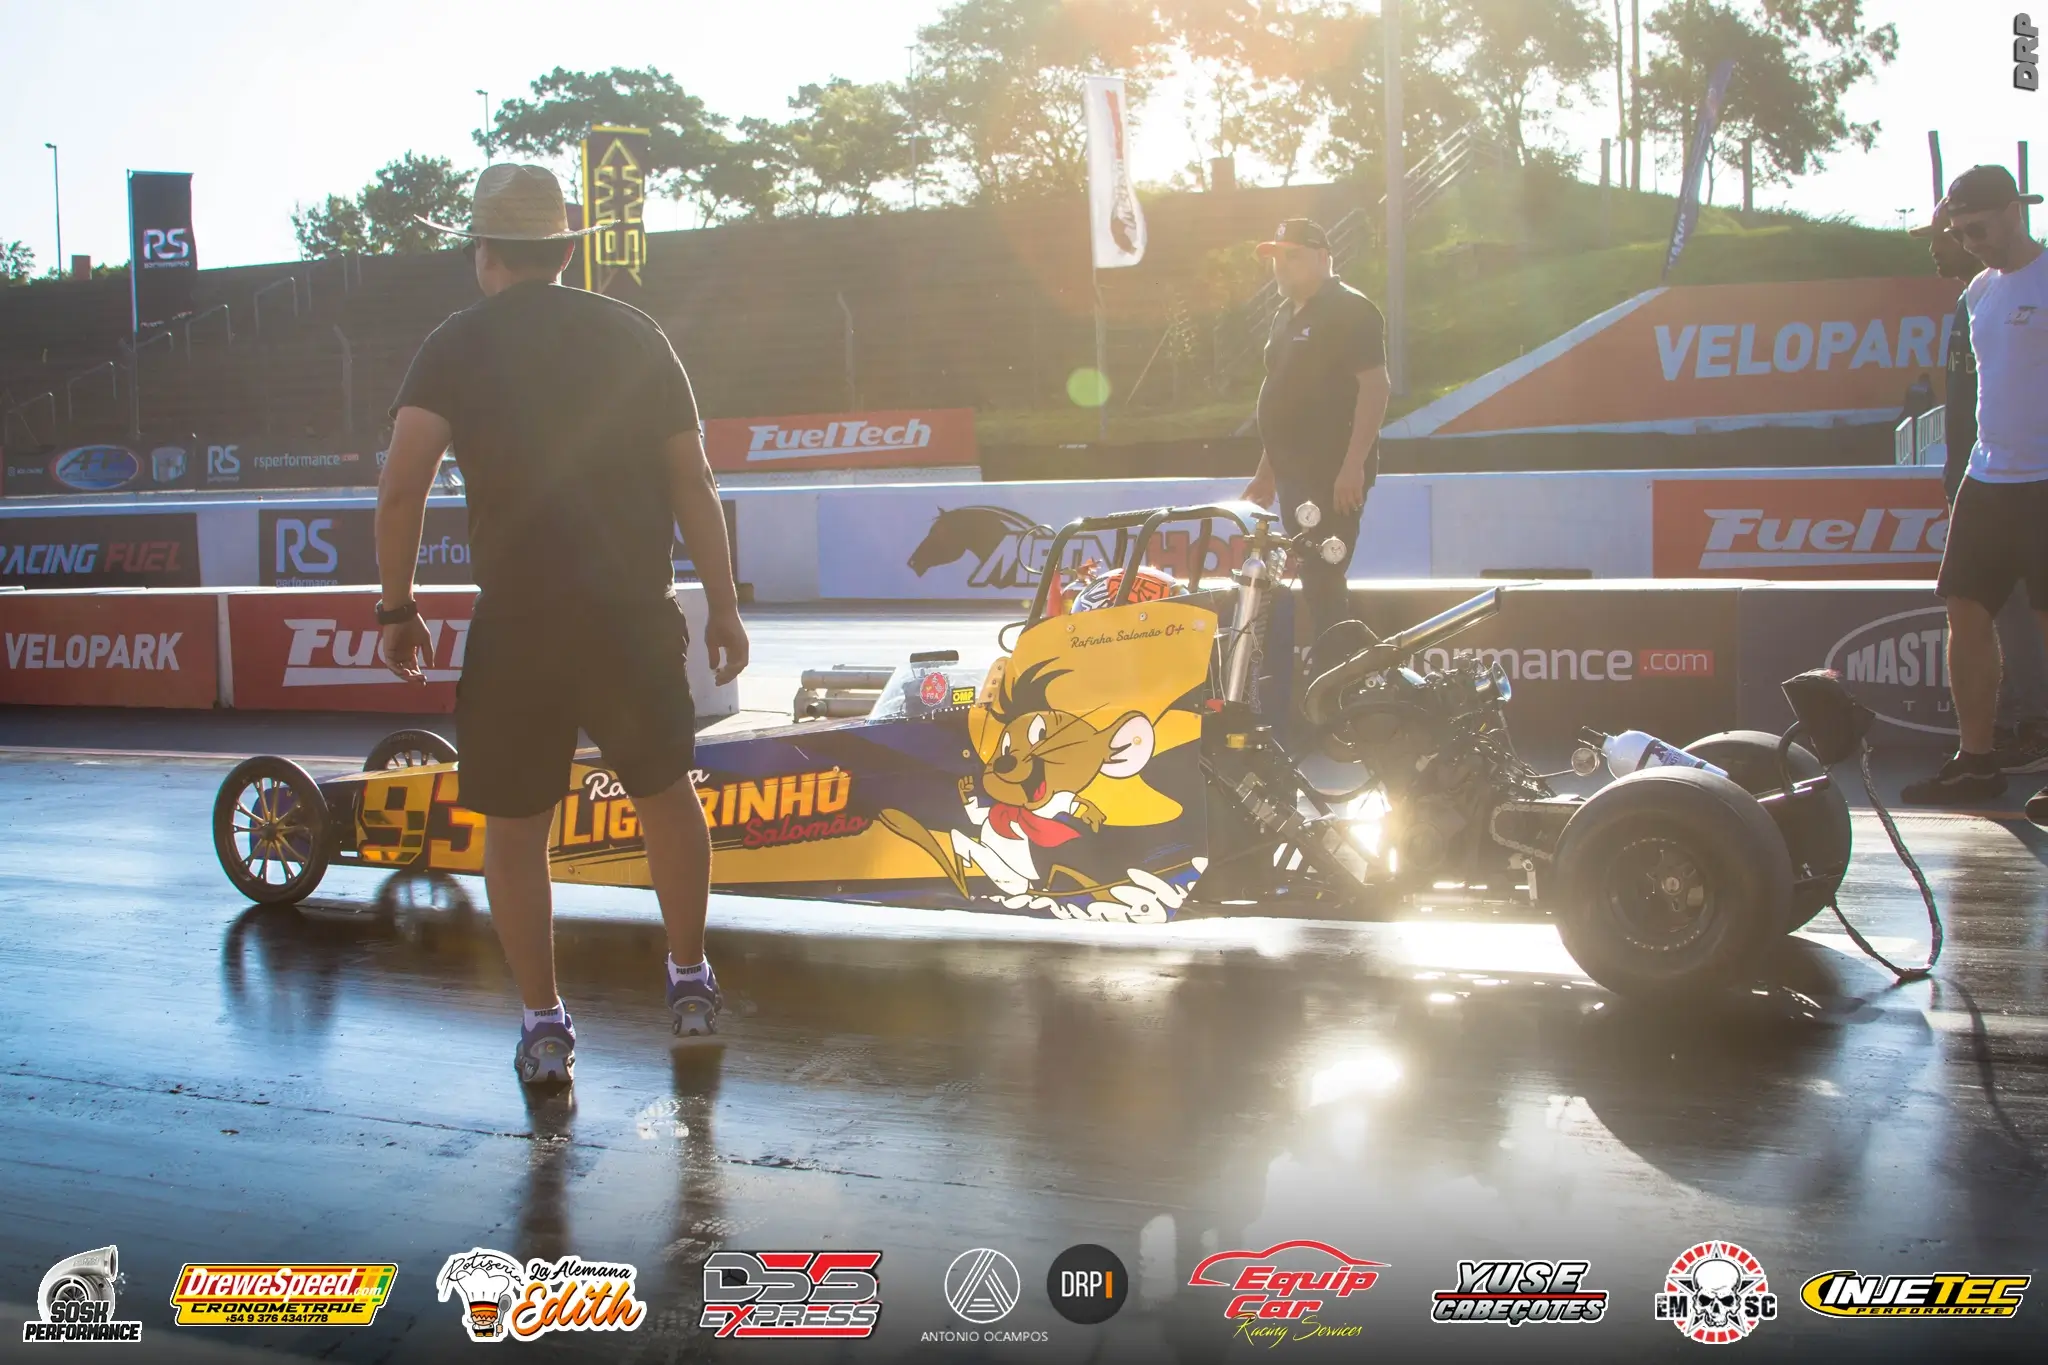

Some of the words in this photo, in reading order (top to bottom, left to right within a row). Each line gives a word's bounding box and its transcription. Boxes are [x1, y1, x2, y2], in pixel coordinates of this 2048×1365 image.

[144, 228, 190, 259] RS
[747, 418, 932, 451] FuelTech
[207, 445, 241, 474] RS
[0, 544, 98, 575] ACING
[104, 541, 181, 573] FUEL
[276, 518, 338, 573] RS
[5, 632, 183, 671] VELOPARK
[1070, 634, 1113, 648] Rafinha
[1116, 628, 1162, 642] Salomão
[952, 691, 974, 702] OMP
[744, 814, 868, 846] Salomão
